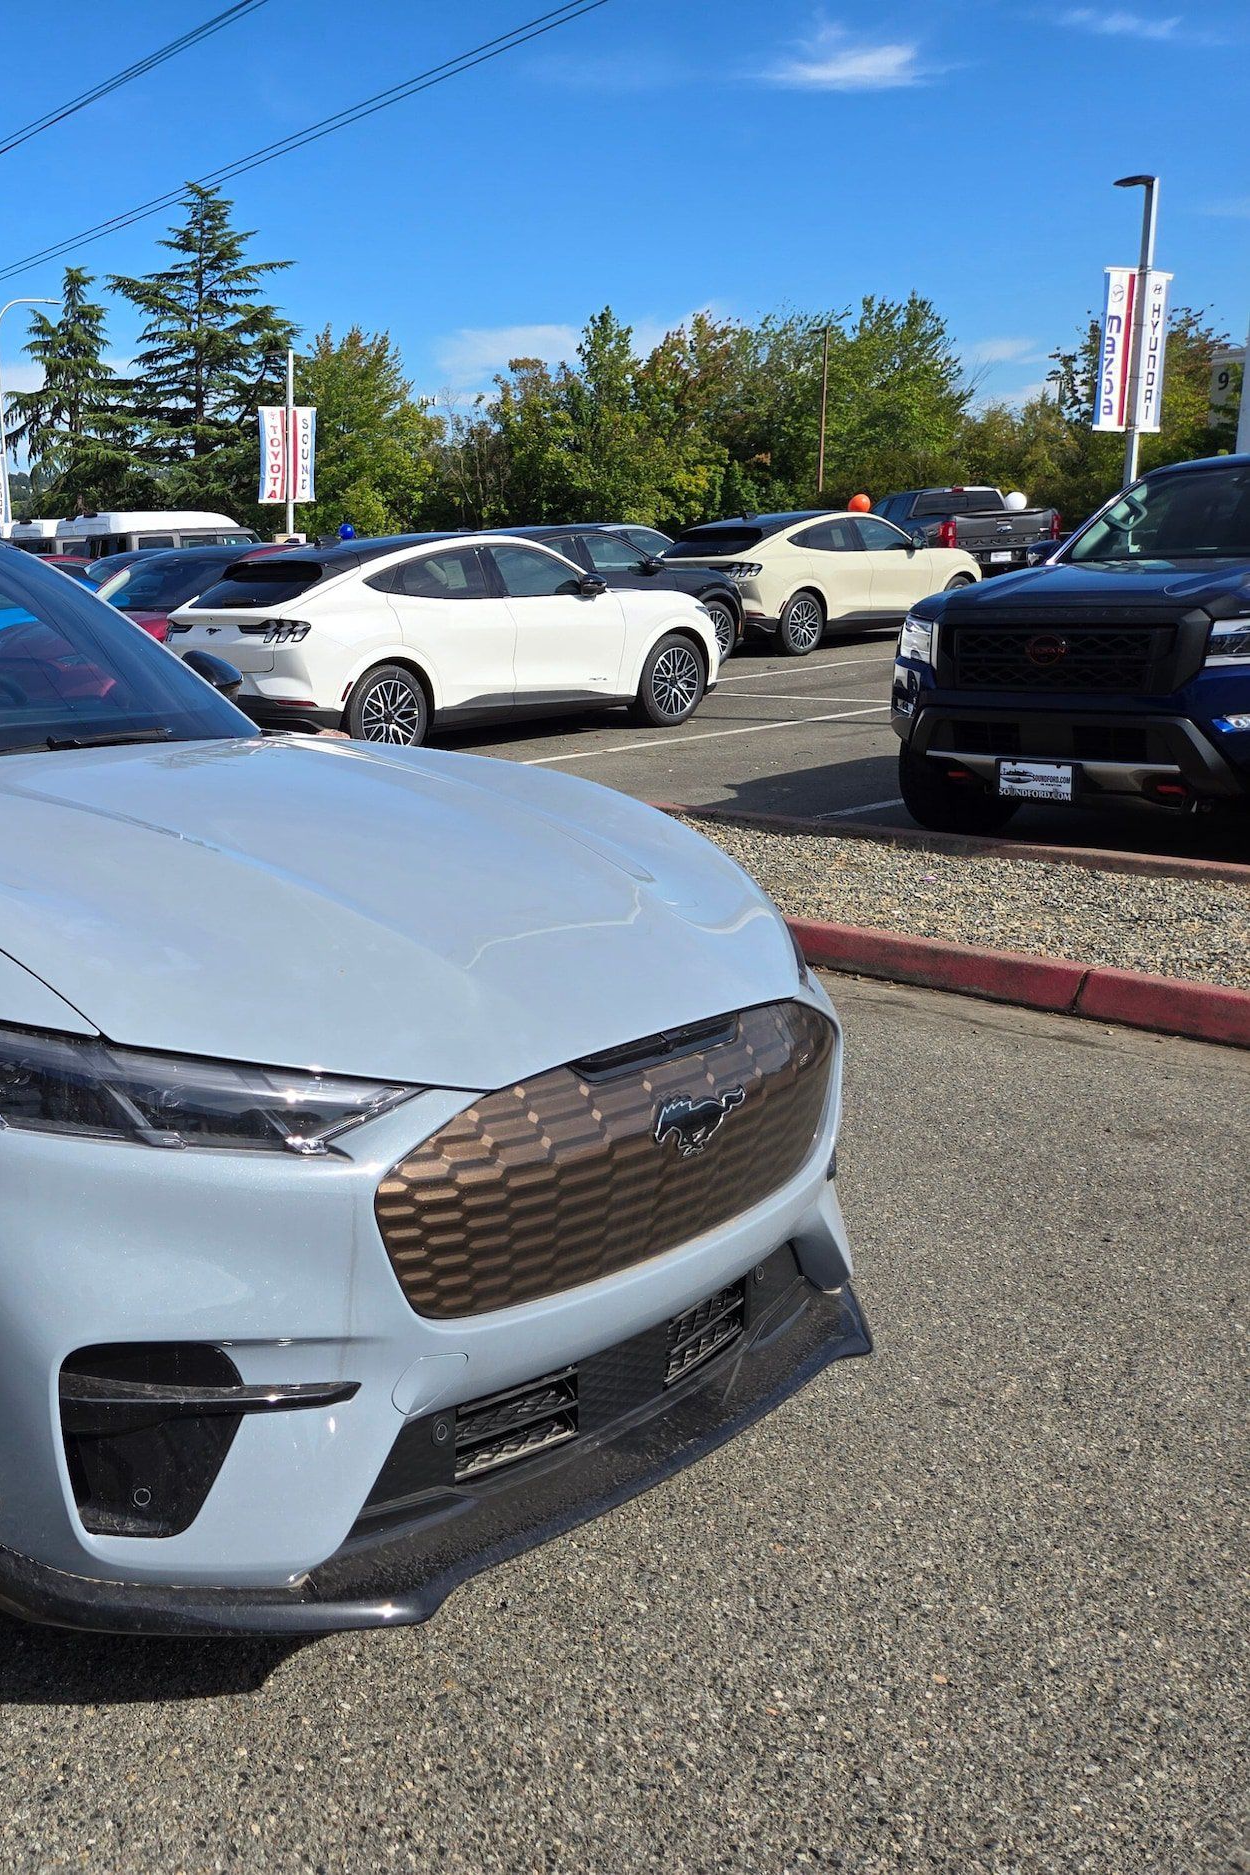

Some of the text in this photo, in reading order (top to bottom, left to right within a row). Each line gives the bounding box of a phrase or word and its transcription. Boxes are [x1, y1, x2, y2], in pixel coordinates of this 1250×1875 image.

[1144, 303, 1161, 420] HYUNDAI
[1217, 371, 1229, 391] 9
[267, 425, 281, 499] TOYOTA
[1032, 774, 1071, 784] SOUNDFORD.COM
[998, 788, 1071, 801] SOUNDFORD.COM
